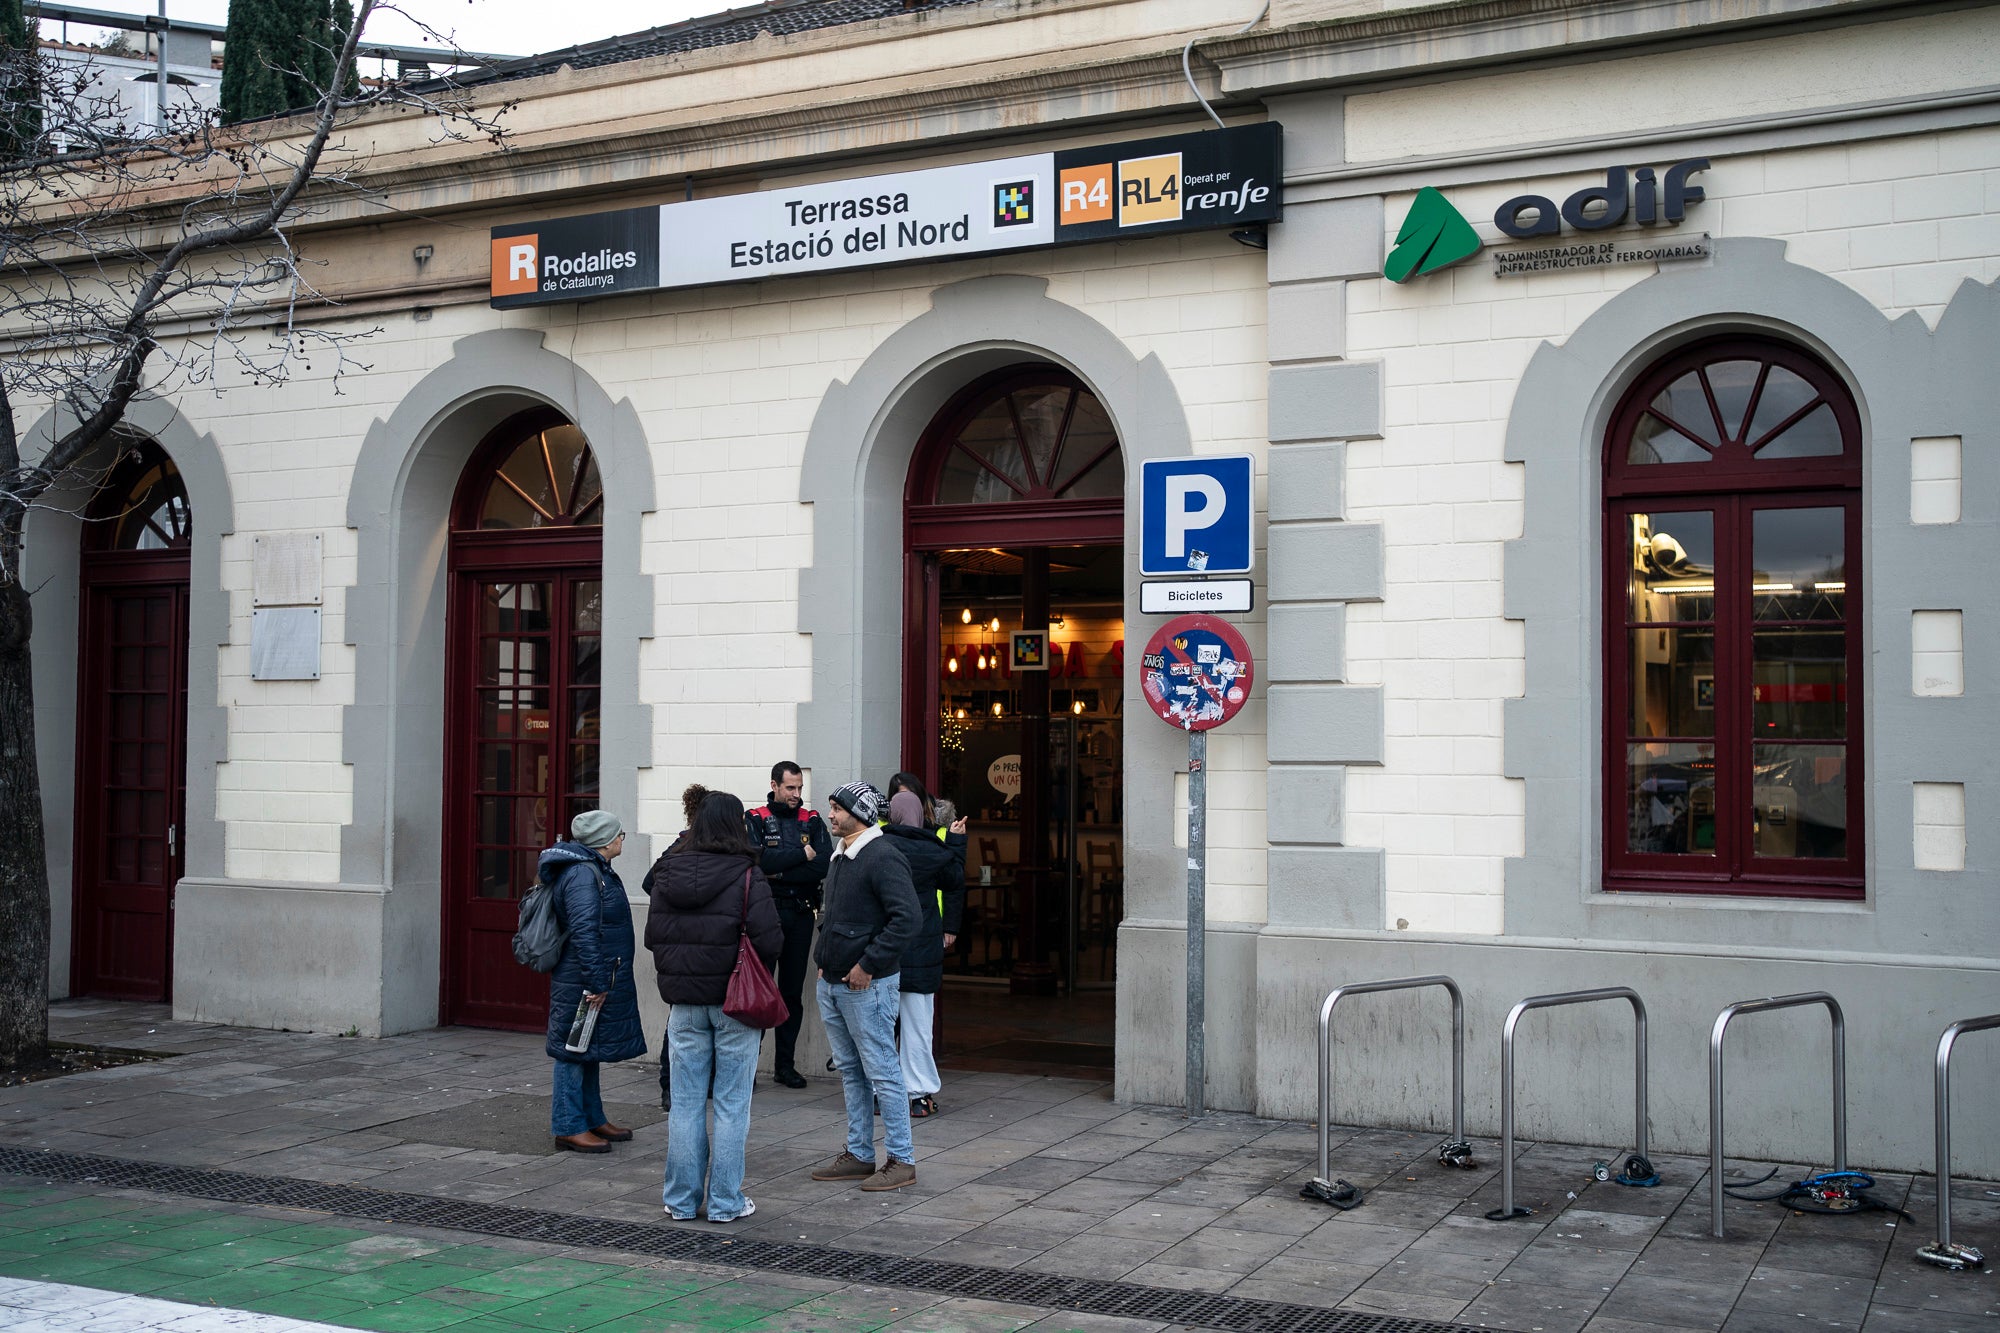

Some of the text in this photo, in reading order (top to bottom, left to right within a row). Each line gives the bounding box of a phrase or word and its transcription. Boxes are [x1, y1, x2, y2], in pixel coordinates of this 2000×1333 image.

[1063, 177, 1109, 212] R4
[1122, 174, 1179, 207] RL4
[1184, 171, 1231, 186] Operat per
[785, 192, 909, 227] Terrassa
[1186, 178, 1270, 215] renfe
[1494, 158, 1711, 239] adif
[730, 213, 969, 268] Estació del Nord
[1500, 243, 1615, 263] ADMINISTRADOR DE
[509, 244, 537, 281] R
[544, 248, 638, 278] Rodalies
[1500, 244, 1702, 274] INFRAESTRUCTURAS FERROVIARIAS
[542, 274, 615, 292] de Catalunya
[1165, 474, 1227, 557] P
[1168, 590, 1223, 601] Bicicletes
